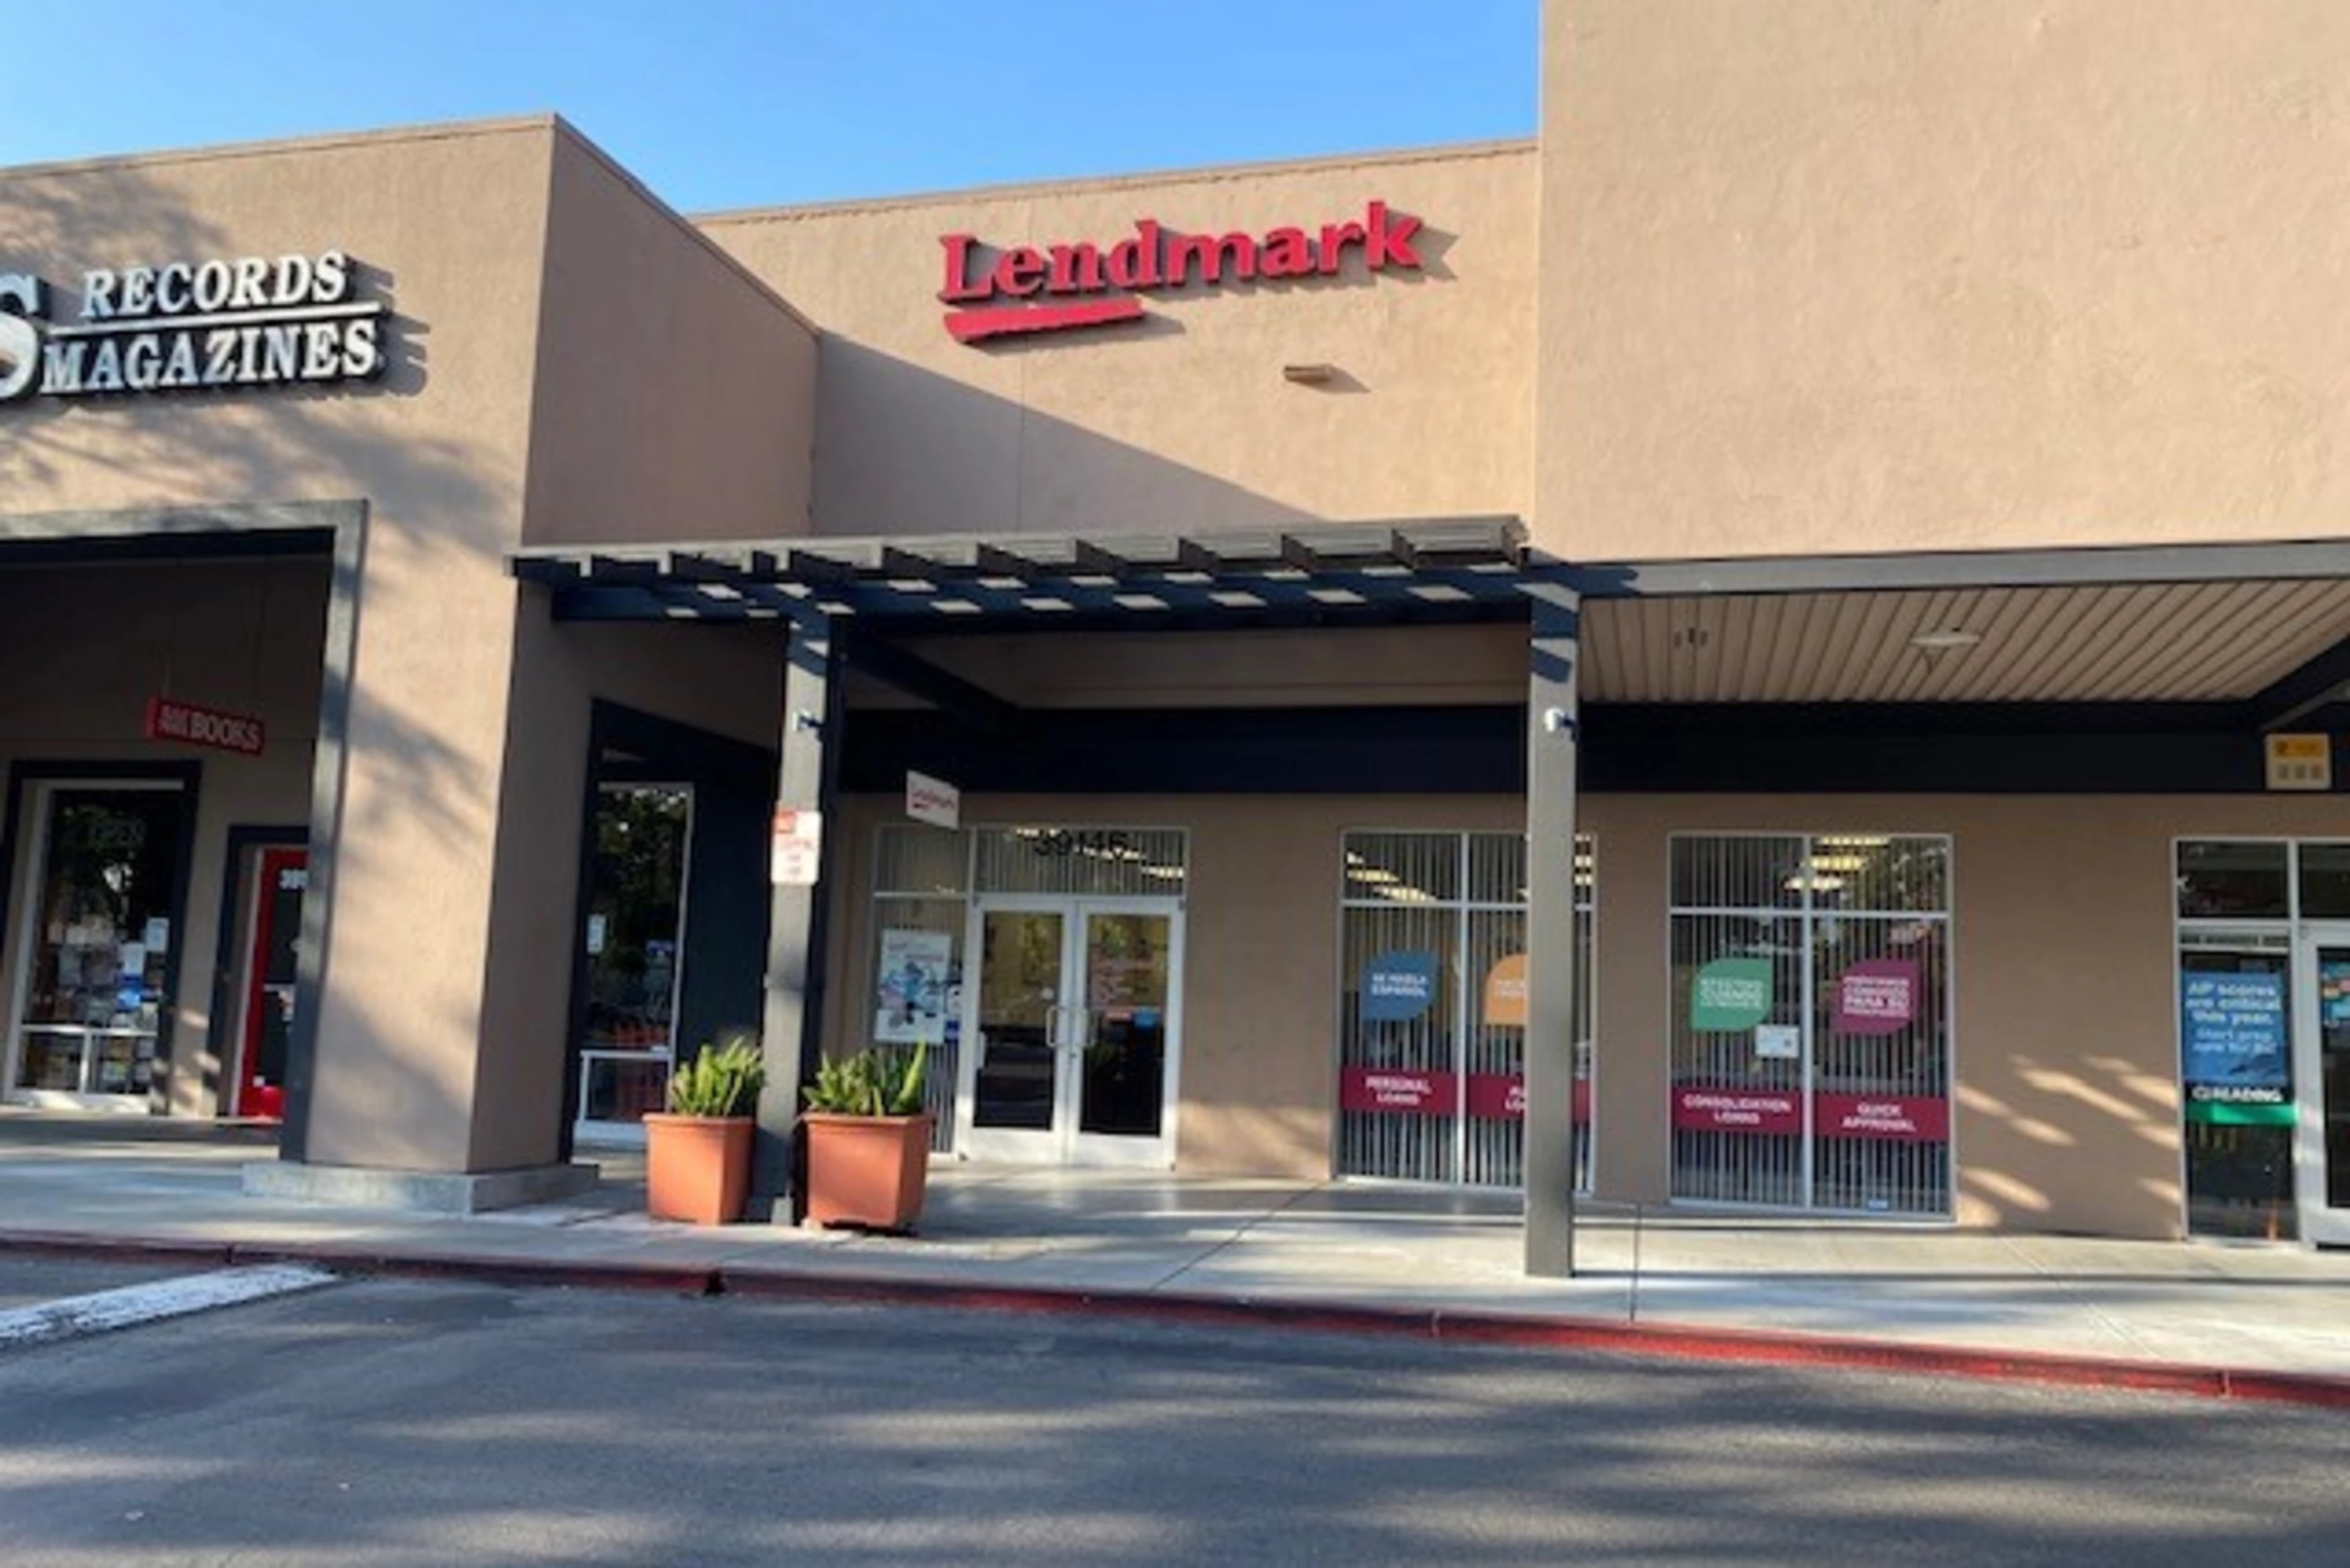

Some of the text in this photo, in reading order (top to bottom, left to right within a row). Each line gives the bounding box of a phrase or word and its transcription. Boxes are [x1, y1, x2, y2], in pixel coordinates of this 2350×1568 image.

[938, 200, 1423, 304] Lendmark
[79, 250, 347, 318] RECORDS
[40, 319, 377, 395] MAGAZINES
[190, 711, 261, 750] BOOKS
[1365, 1075, 1433, 1095] PERSONAL
[1376, 1093, 1421, 1106] LOANS
[1682, 1094, 1792, 1113] CONSOLIDATION
[1714, 1111, 1761, 1125] LOANS
[1856, 1102, 1903, 1118] QUICK
[1841, 1116, 1918, 1133] APPROVAL
